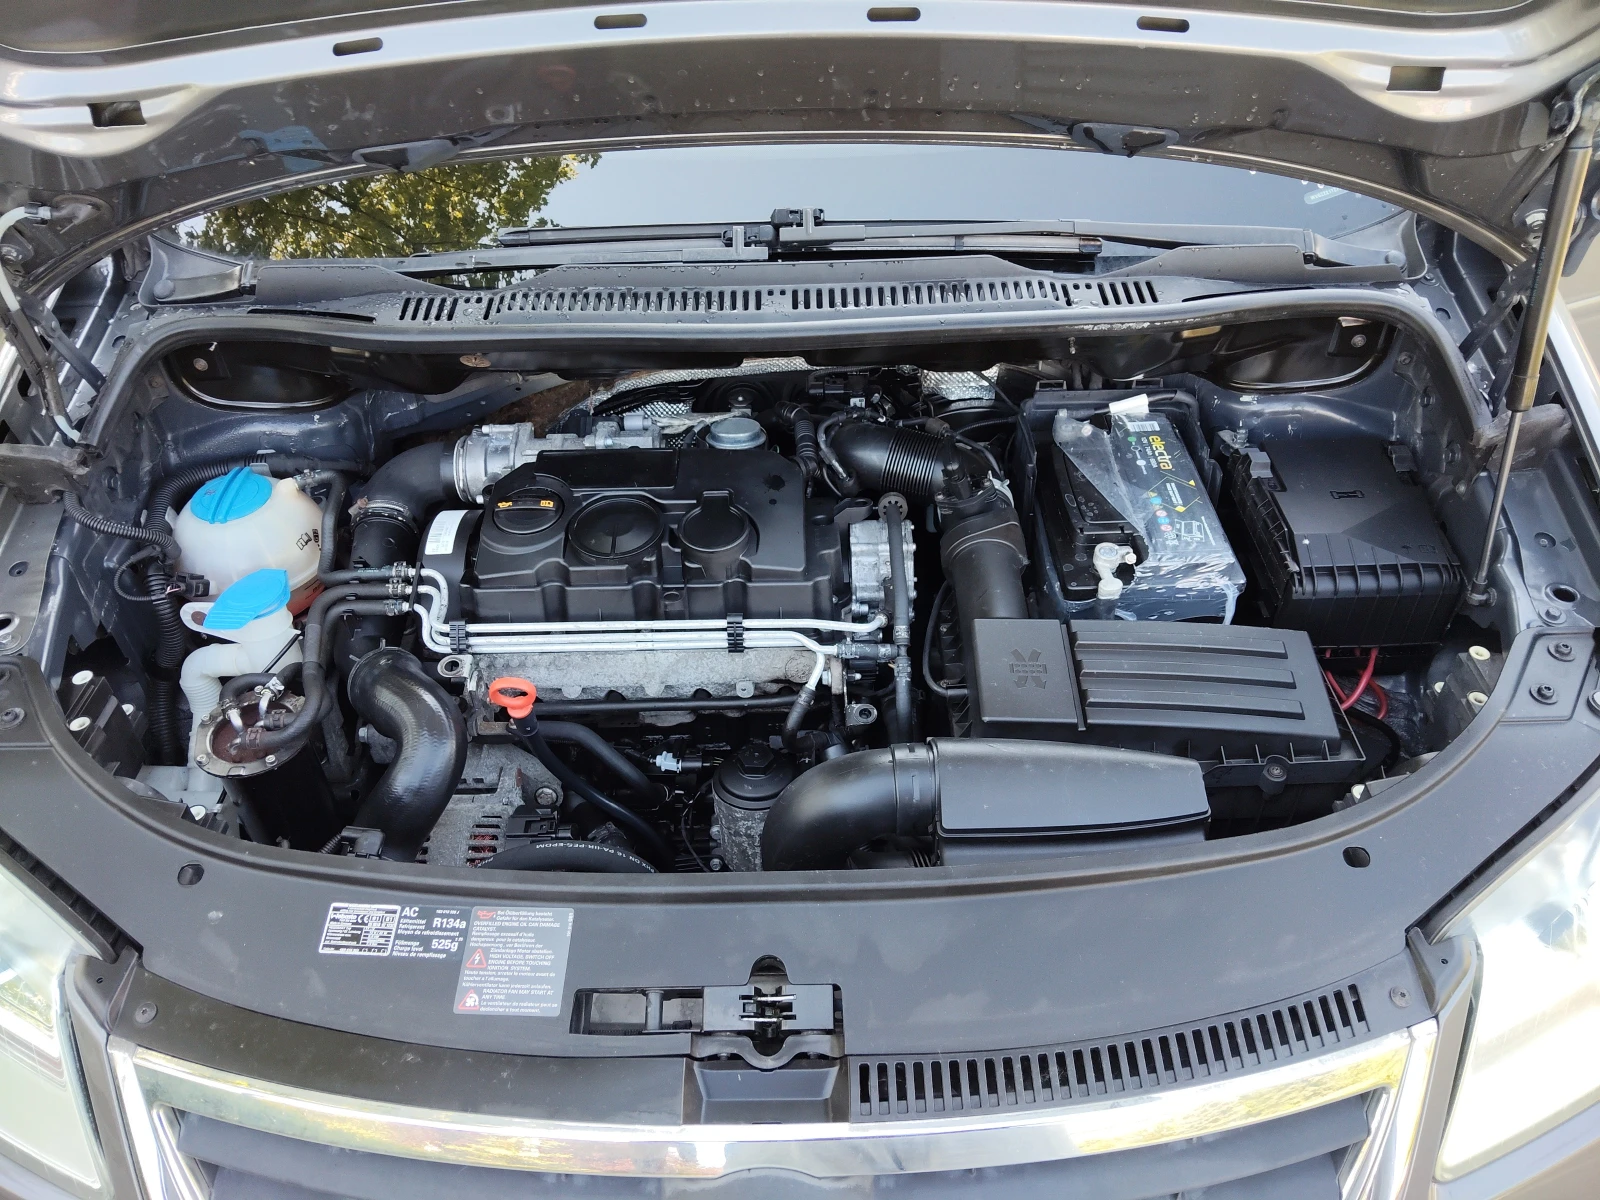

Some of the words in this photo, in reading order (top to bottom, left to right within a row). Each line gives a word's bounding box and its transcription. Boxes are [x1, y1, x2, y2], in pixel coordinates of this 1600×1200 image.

[1149, 435, 1173, 470] electra
[401, 906, 419, 917] AC
[432, 917, 466, 929] R134a
[431, 938, 459, 952] 525g
